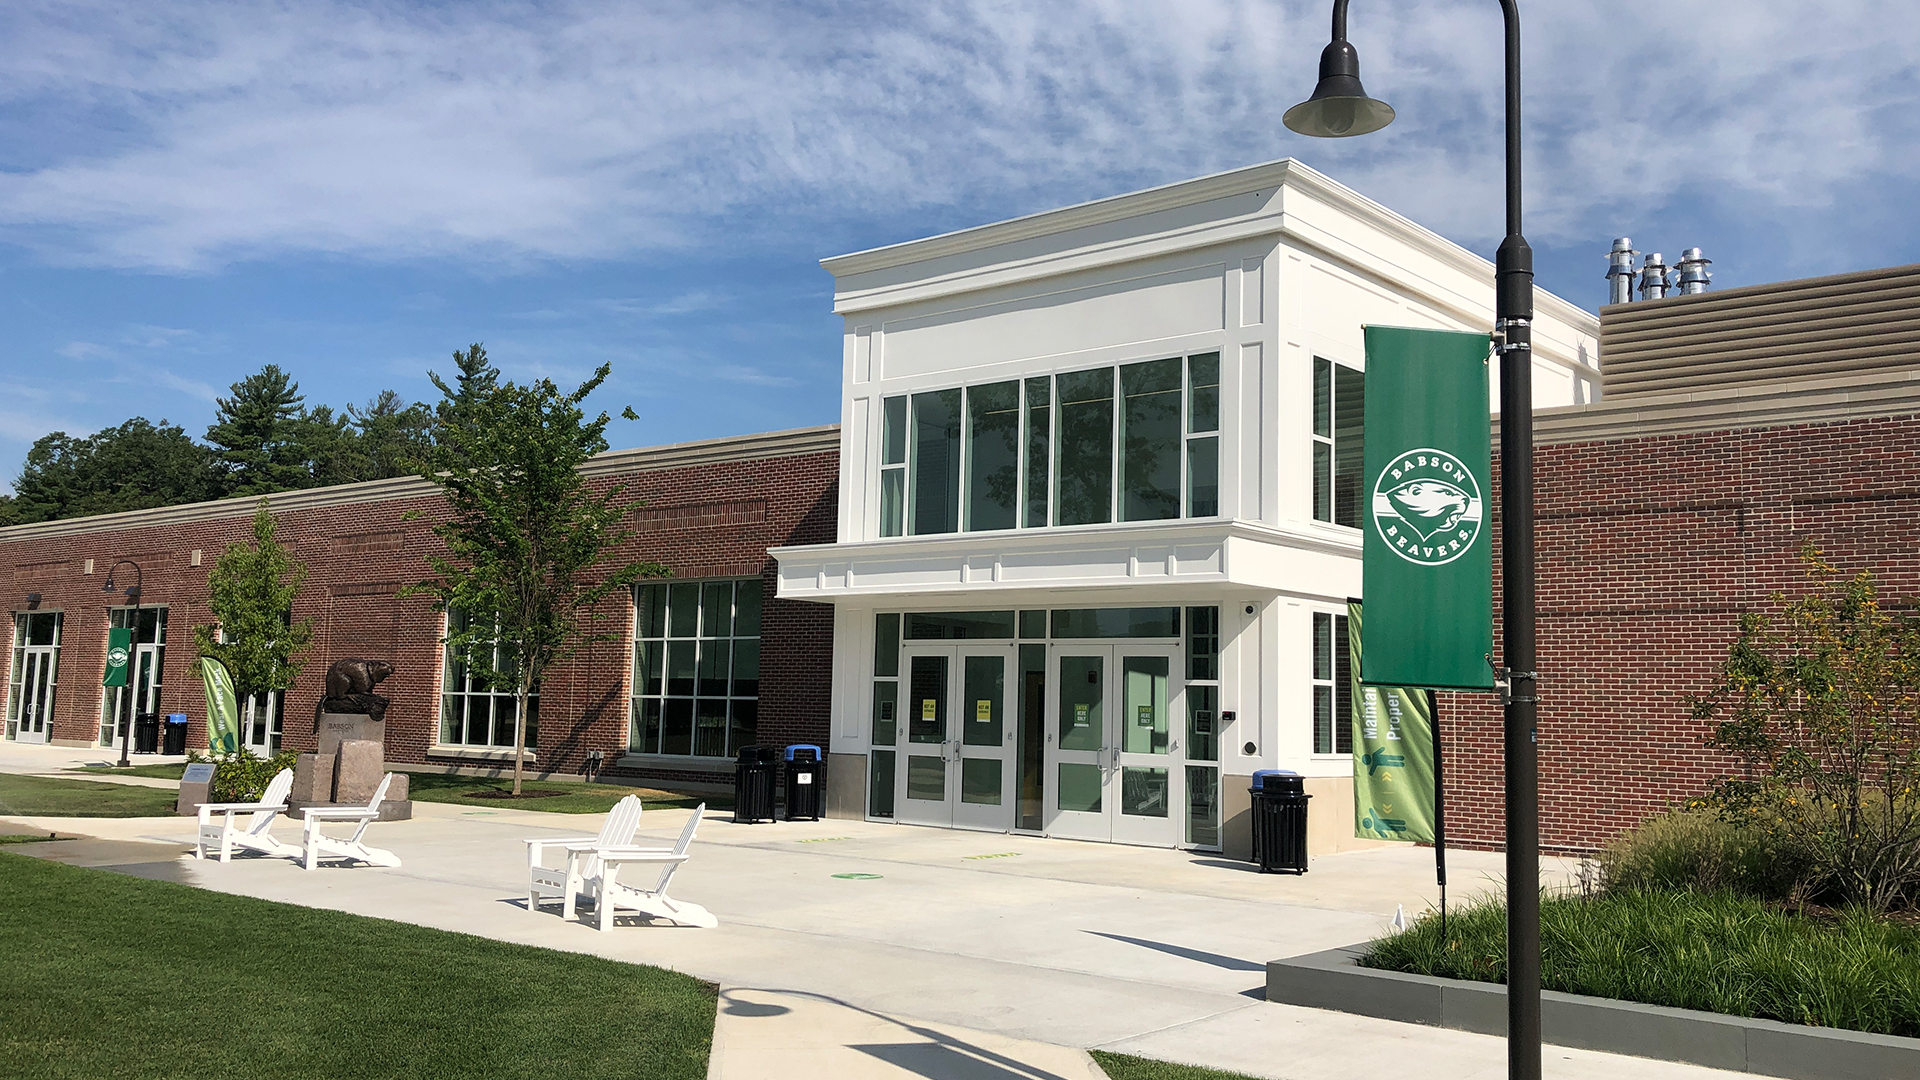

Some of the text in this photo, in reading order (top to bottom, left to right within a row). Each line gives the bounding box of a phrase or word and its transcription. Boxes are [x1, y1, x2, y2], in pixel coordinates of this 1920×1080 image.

[1391, 456, 1466, 483] BABSON
[1386, 525, 1469, 558] BEAVERS
[216, 687, 224, 705] Face
[1362, 688, 1378, 739] Maintai
[1386, 692, 1403, 741] Proper
